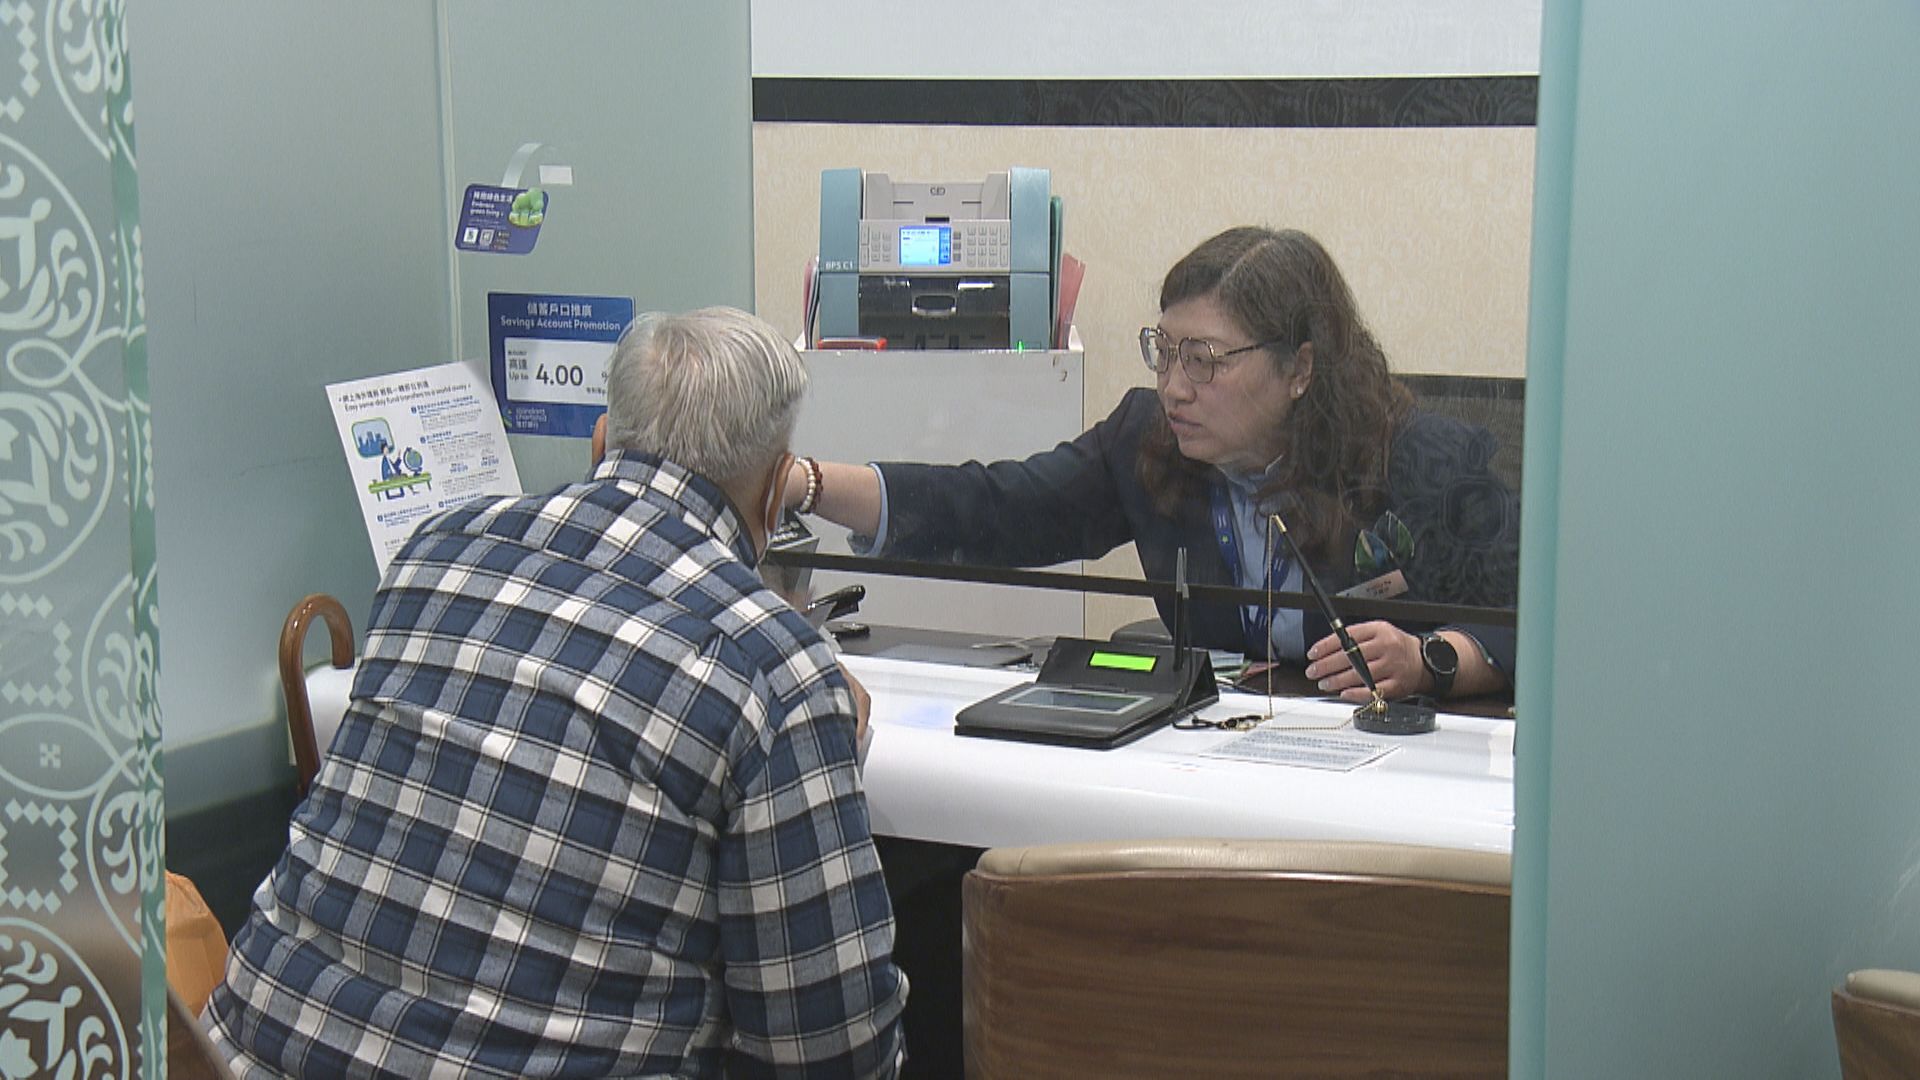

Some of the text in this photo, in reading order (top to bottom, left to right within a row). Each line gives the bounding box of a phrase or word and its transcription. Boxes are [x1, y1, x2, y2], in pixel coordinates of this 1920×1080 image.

[501, 315, 620, 330] Savings Account Promotion
[509, 371, 529, 381] Up to
[536, 363, 583, 386] 4.00
[345, 403, 358, 412] Easy
